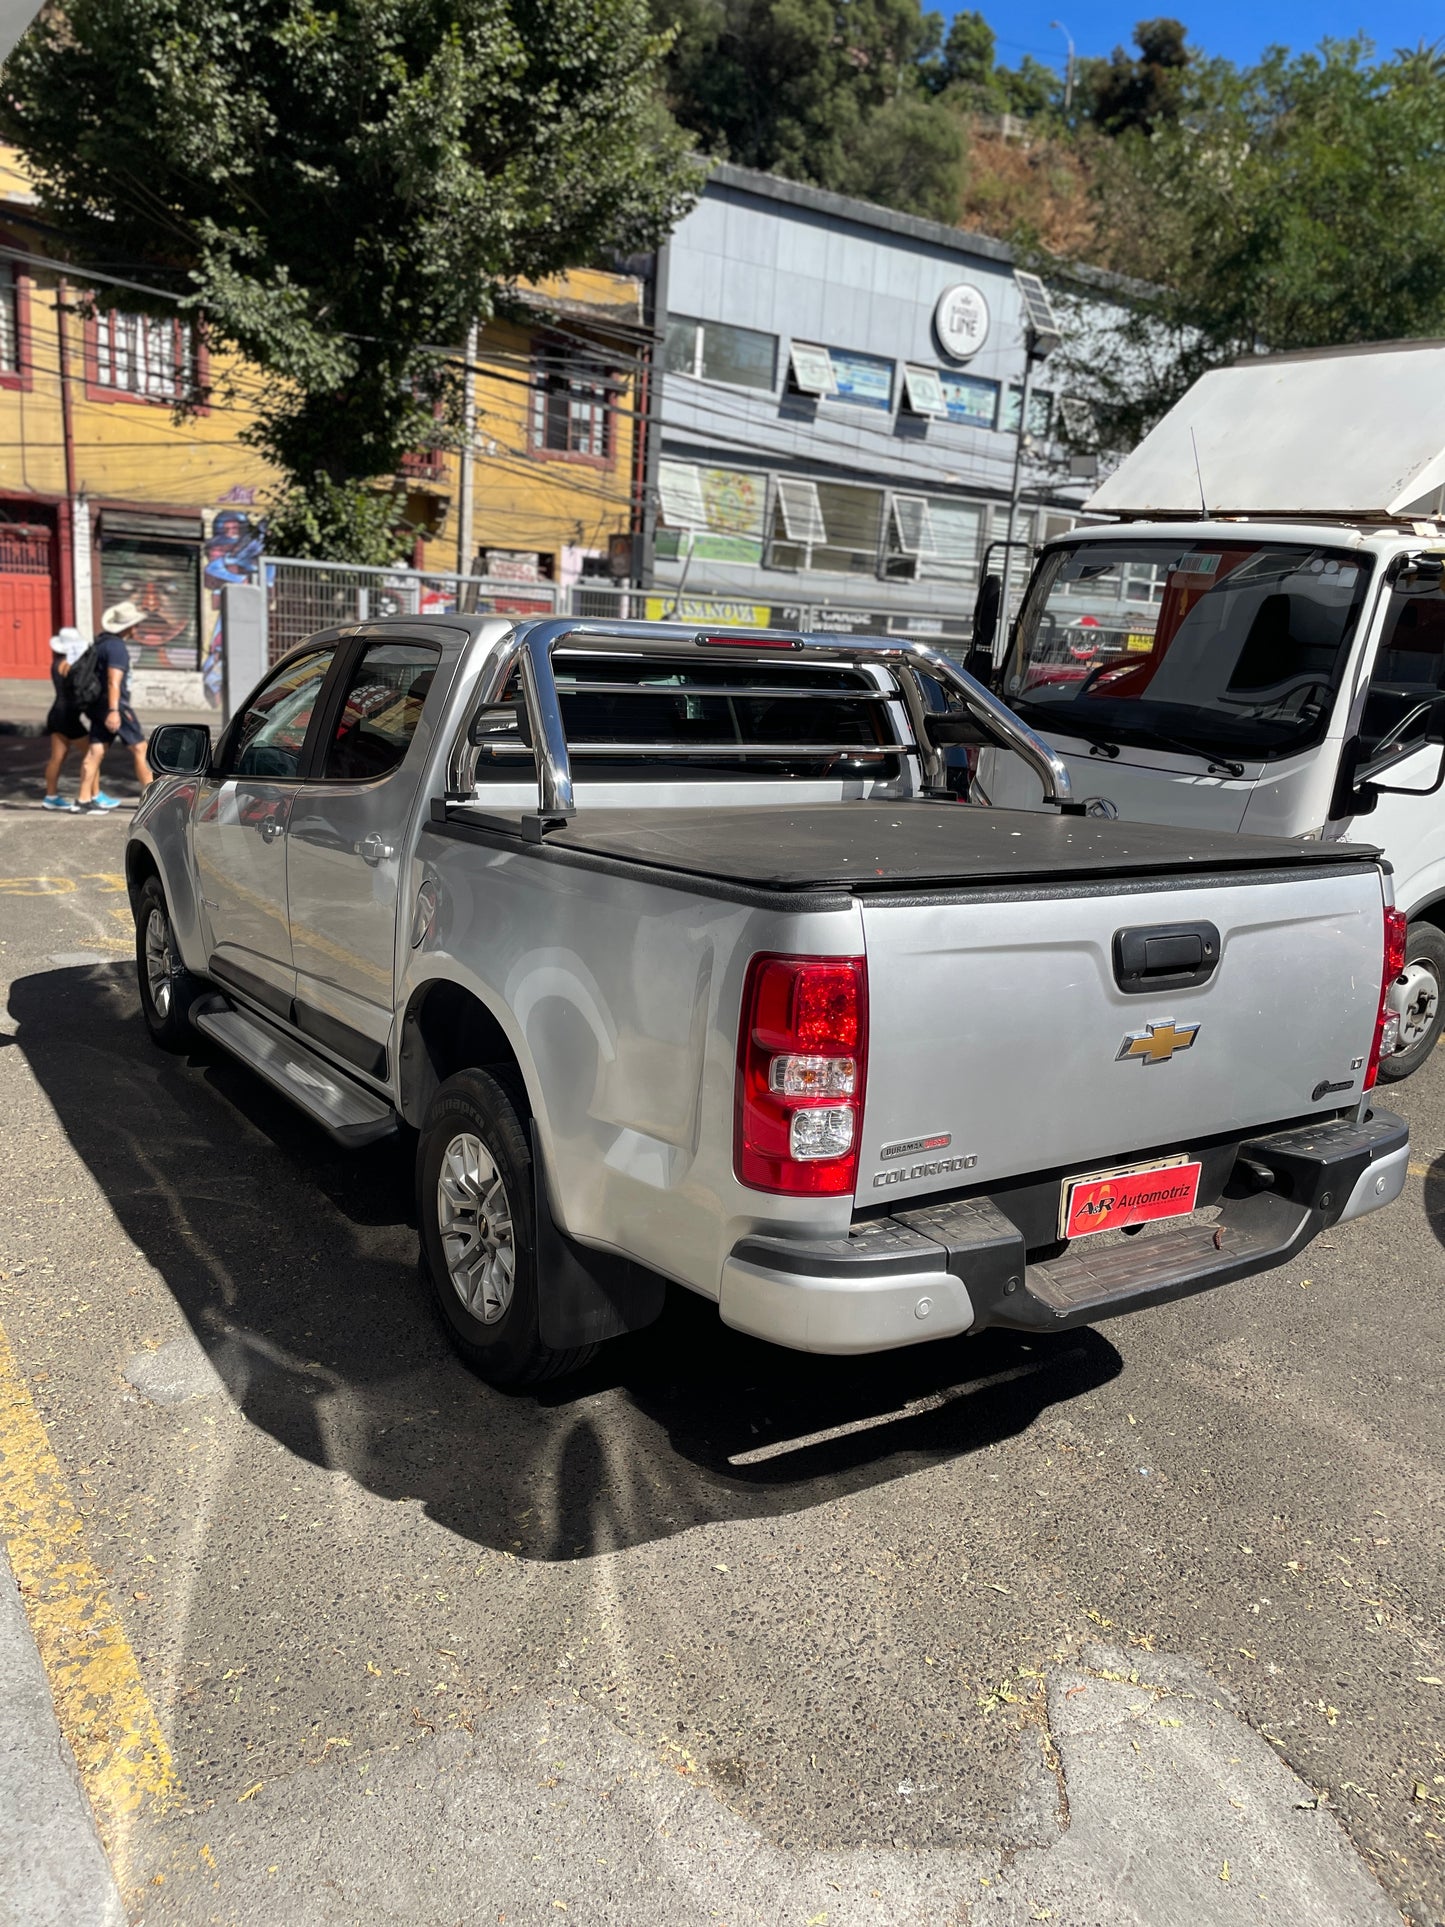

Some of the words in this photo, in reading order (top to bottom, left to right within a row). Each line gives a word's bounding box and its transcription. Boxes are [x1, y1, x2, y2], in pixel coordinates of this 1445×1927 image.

[886, 1142, 923, 1156] DURAMAX
[873, 1154, 978, 1187] COLORADO
[1075, 1197, 1115, 1218] A&R
[1117, 1184, 1192, 1209] Automotriz
